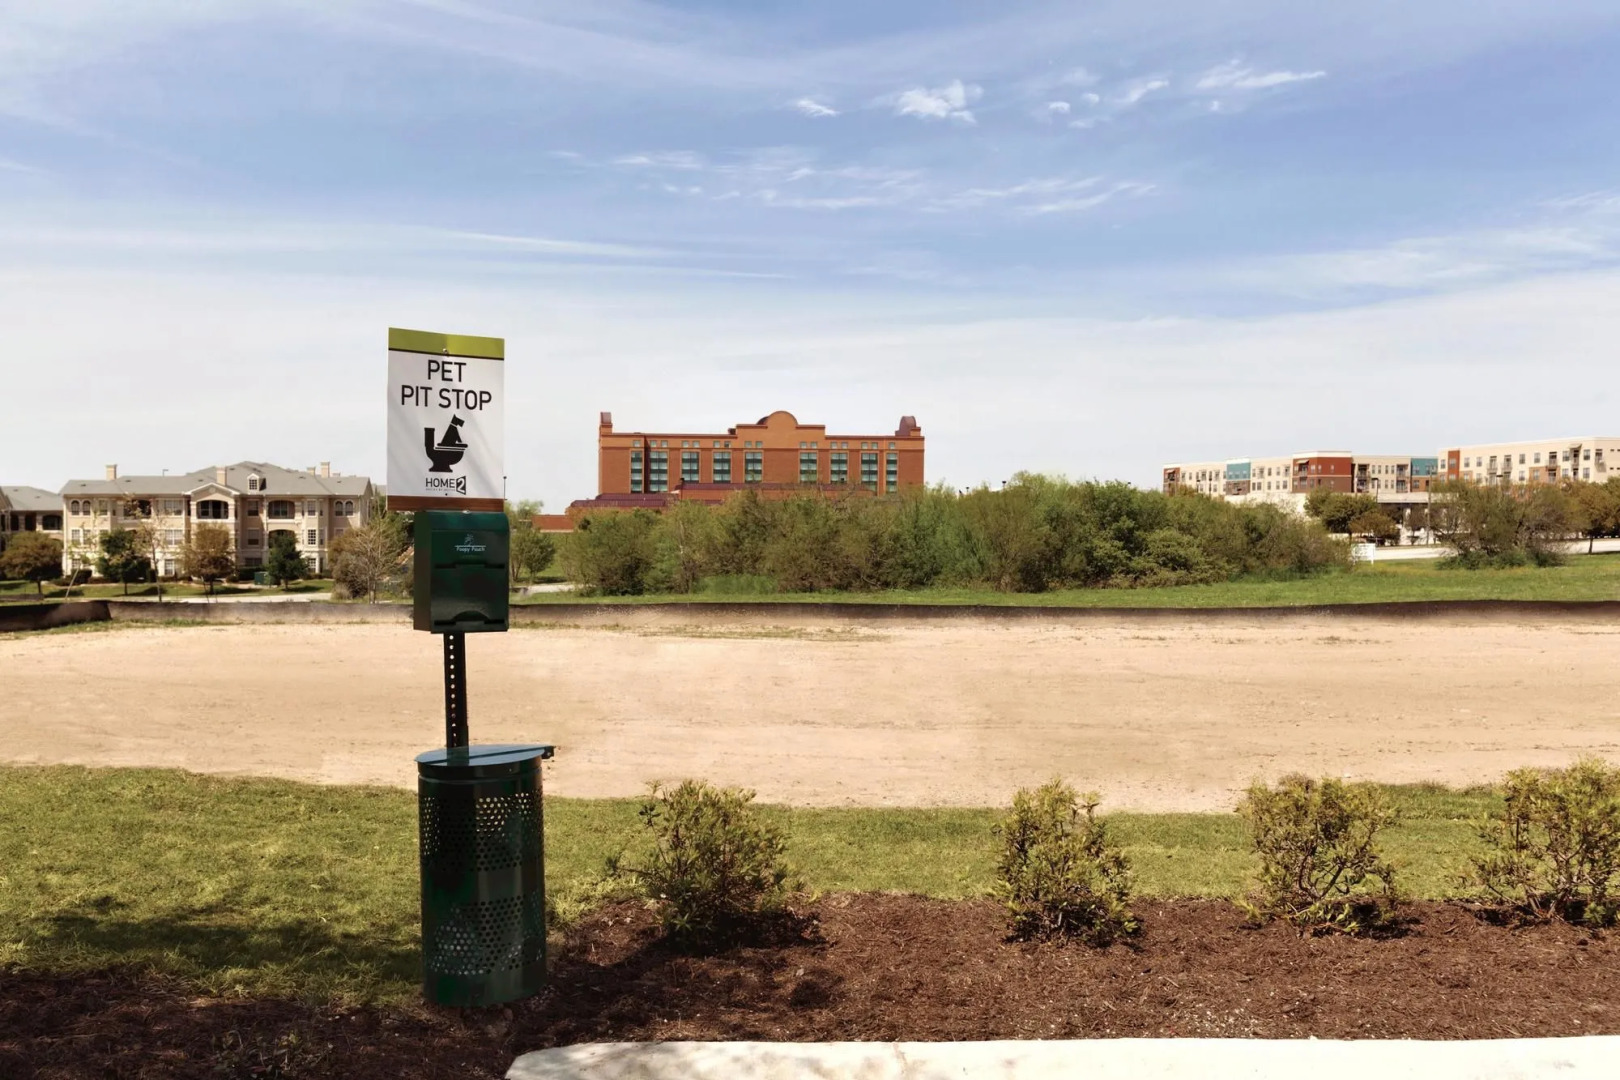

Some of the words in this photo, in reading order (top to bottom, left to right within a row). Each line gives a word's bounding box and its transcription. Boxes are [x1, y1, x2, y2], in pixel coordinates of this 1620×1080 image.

[427, 359, 467, 383] PET
[401, 384, 432, 407] PIT
[438, 387, 492, 411] STOP
